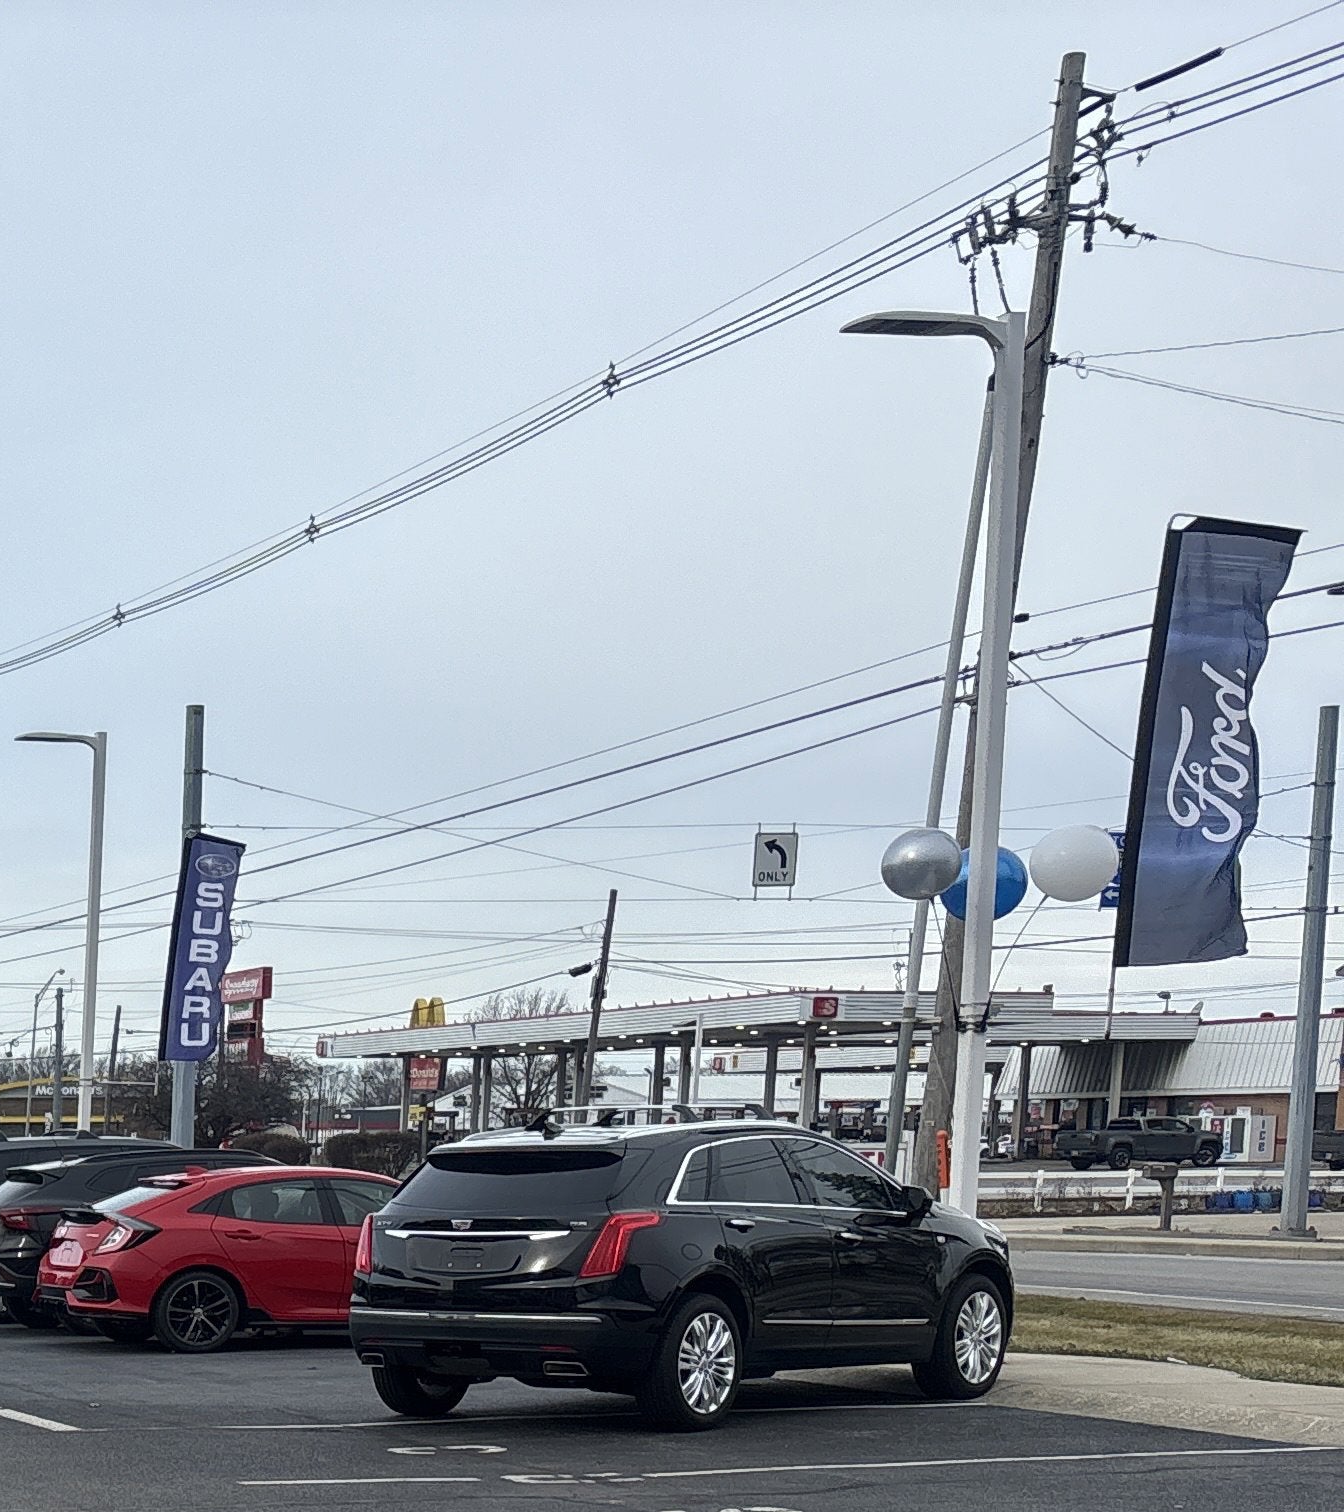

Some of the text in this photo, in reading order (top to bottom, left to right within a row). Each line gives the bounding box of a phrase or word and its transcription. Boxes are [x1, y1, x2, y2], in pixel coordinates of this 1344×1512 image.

[1167, 660, 1250, 843] Ford
[758, 871, 789, 882] ONLY
[180, 882, 225, 1047] SUBARU
